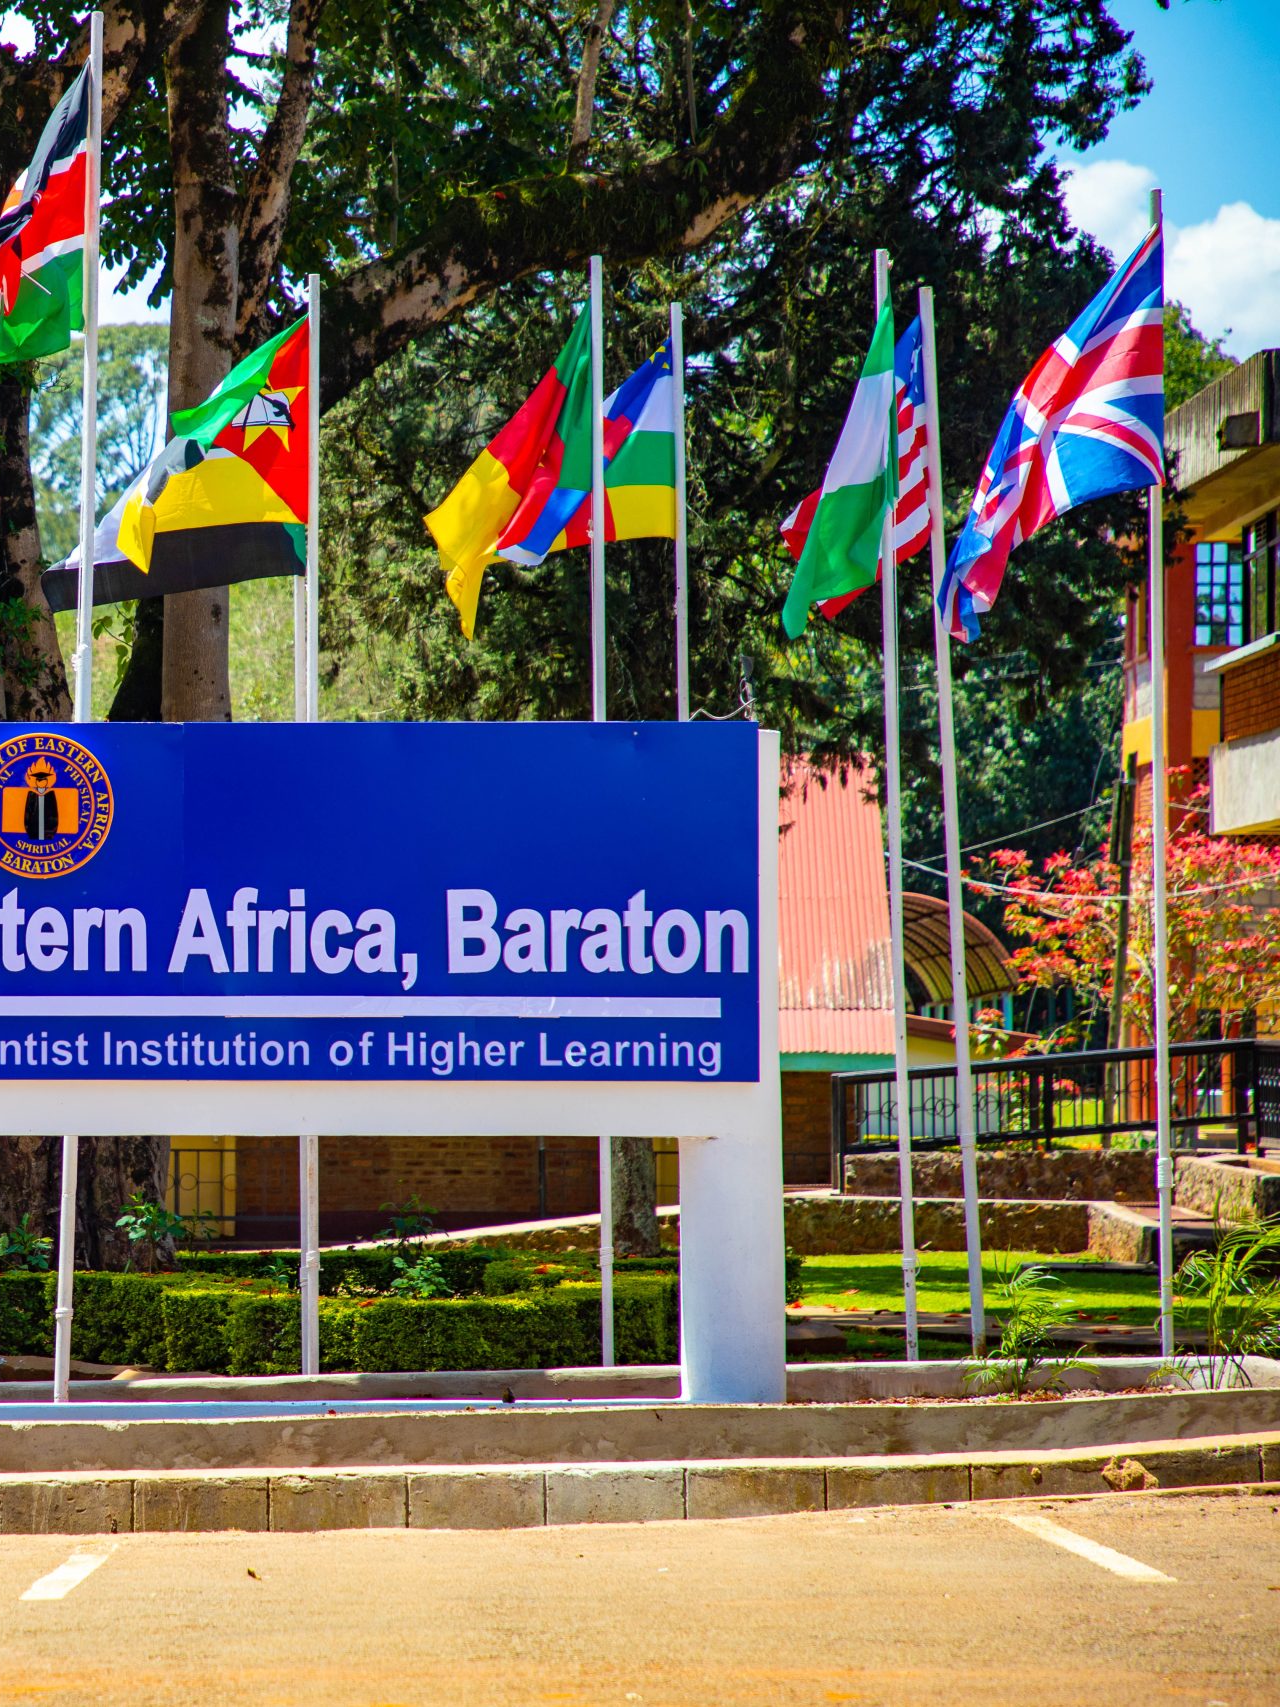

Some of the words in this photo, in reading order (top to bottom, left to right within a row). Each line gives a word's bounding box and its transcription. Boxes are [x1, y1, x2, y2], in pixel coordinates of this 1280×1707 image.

[5, 739, 28, 757] OF
[34, 737, 103, 784] EASTERN
[63, 764, 91, 825] PHYSICAL
[77, 791, 109, 851] AFRICA,
[1, 850, 75, 874] BARATON
[15, 837, 72, 854] SPIRITUAL
[167, 886, 418, 991] Africa,
[446, 888, 750, 975] Baraton
[103, 1031, 310, 1067] Institution
[329, 1031, 375, 1067] of
[388, 1031, 526, 1076] Higher
[539, 1032, 722, 1077] Learning
